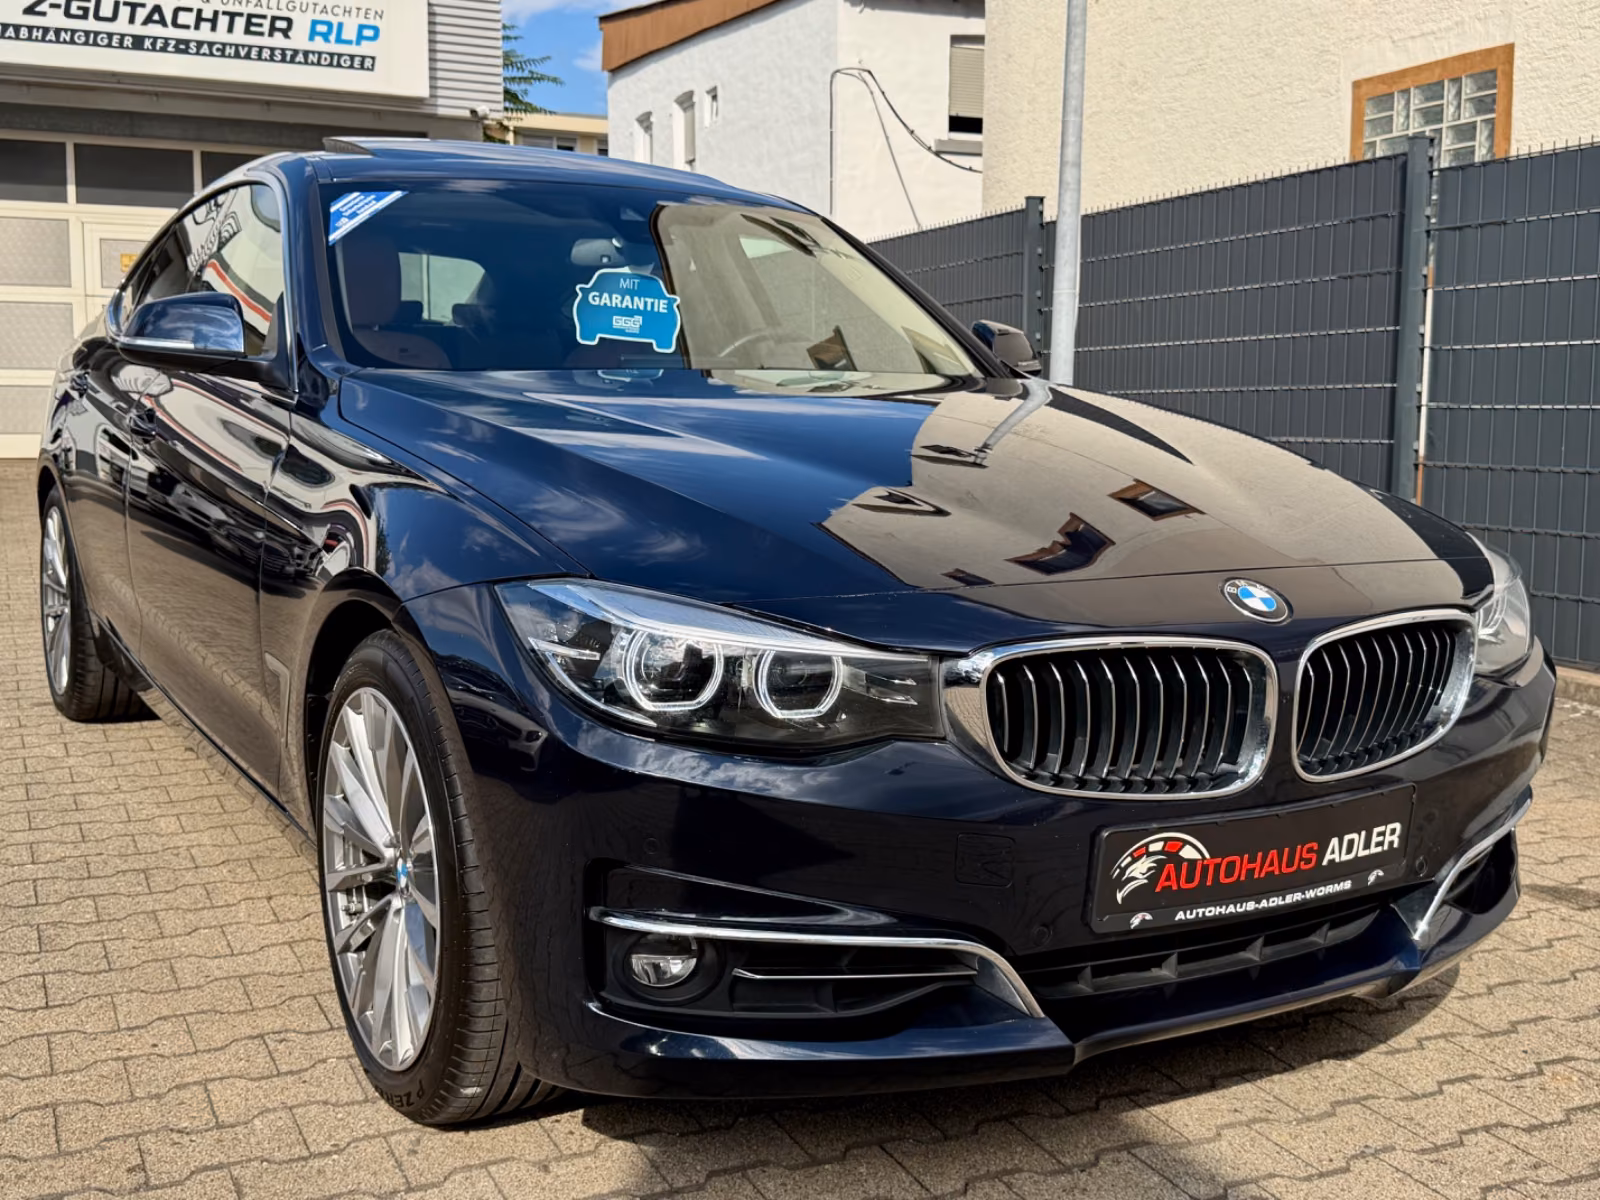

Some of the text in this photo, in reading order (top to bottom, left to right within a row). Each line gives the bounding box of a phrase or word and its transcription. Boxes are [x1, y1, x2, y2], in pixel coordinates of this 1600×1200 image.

[220, 0, 385, 21] UNFALLGUTACHTEN
[307, 18, 381, 47] RLP
[0, 25, 374, 70] ABHÄNGIGER KFZ-SACHVERSTÄNDIGER
[619, 278, 640, 290] MIT
[588, 291, 668, 313] GARANTIE
[1154, 822, 1401, 893] AUTOHAUS ADLER
[1174, 879, 1352, 921] AUTOHAUS-ADLER-WORMS
